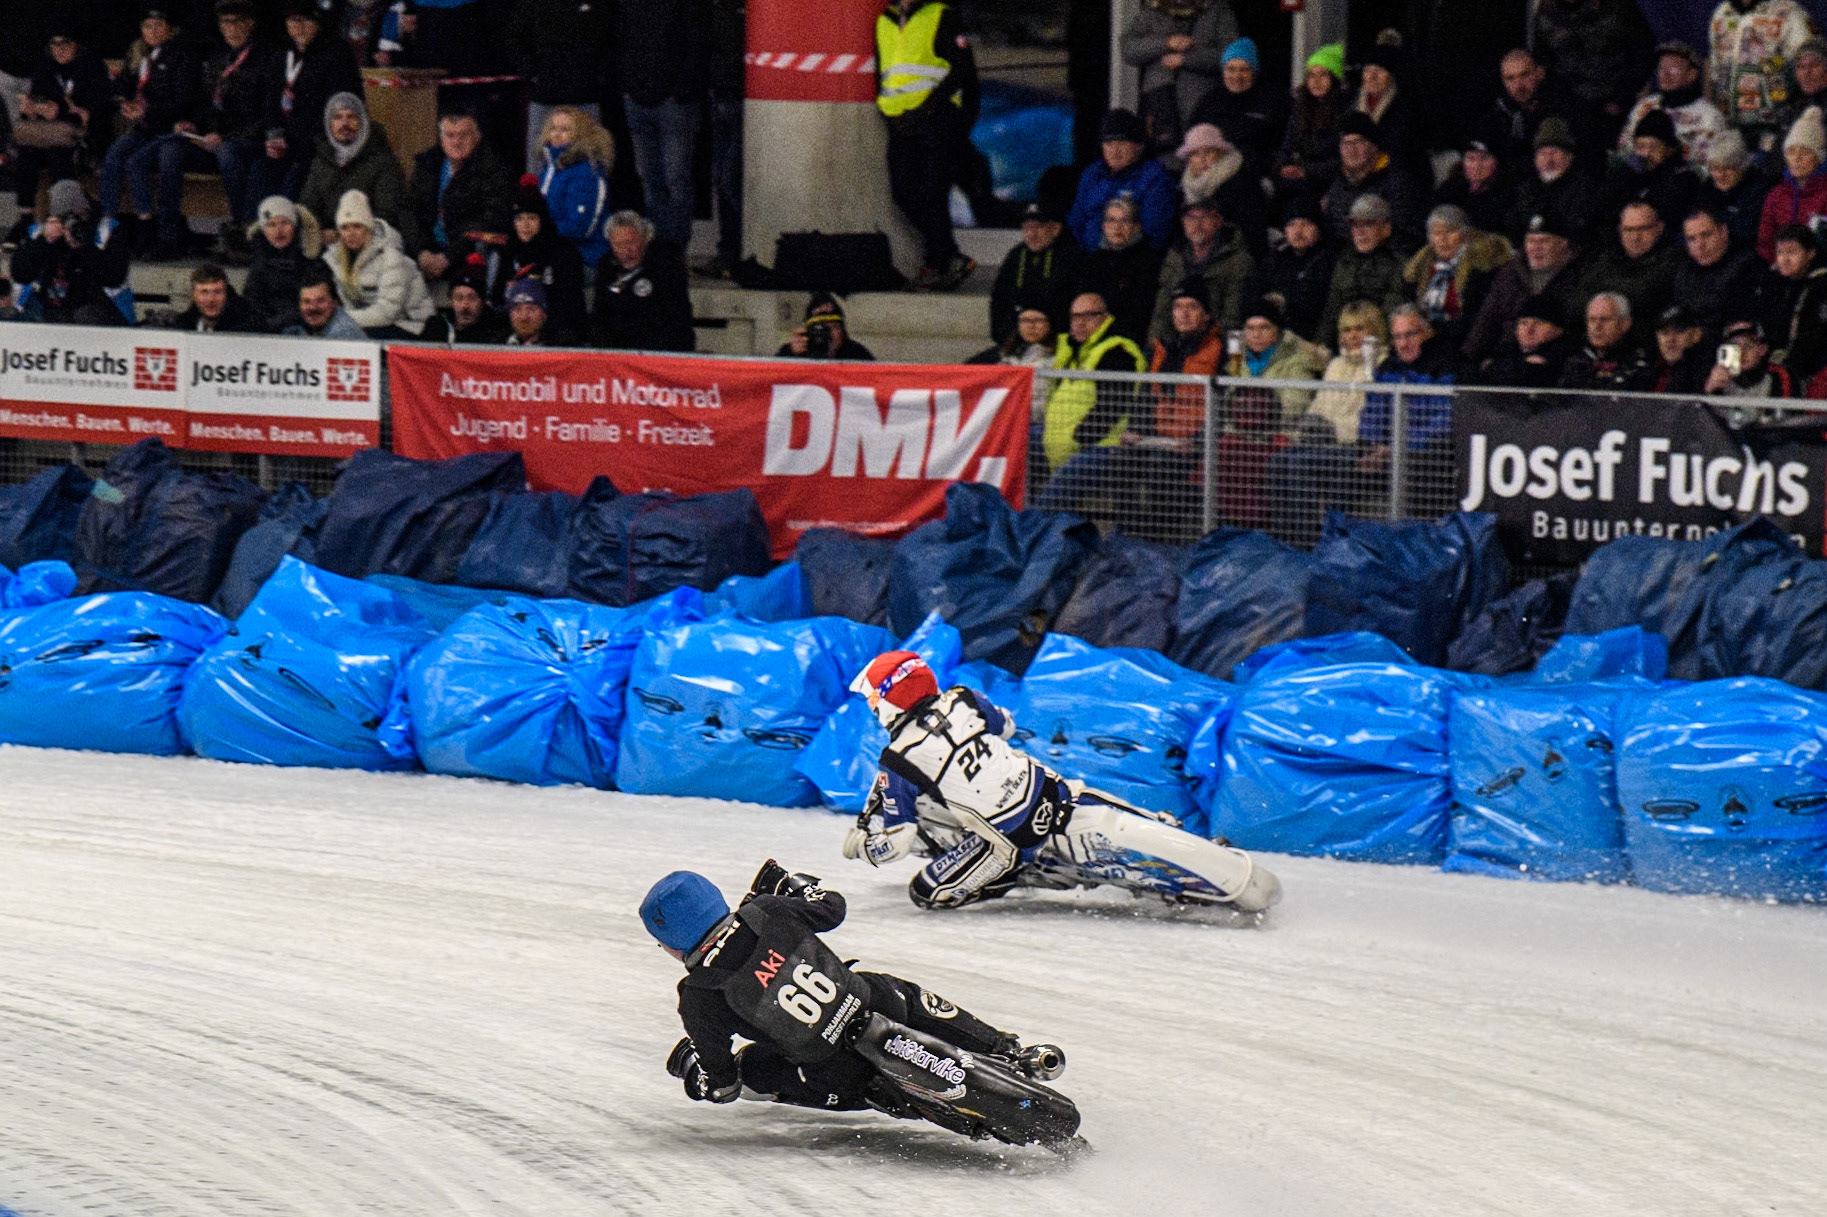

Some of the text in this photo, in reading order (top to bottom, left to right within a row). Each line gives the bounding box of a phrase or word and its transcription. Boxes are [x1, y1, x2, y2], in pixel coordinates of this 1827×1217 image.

[0, 347, 129, 376] Josef Fuchs
[191, 359, 321, 387] Josef Fuchs
[440, 371, 722, 409] Automobil und Motorrad
[450, 412, 715, 447] Jugend Familie Freizeit
[1461, 429, 1810, 517] Josef Fuchs
[957, 738, 993, 784] 24
[754, 949, 787, 989] Aki
[777, 963, 837, 1024] 66
